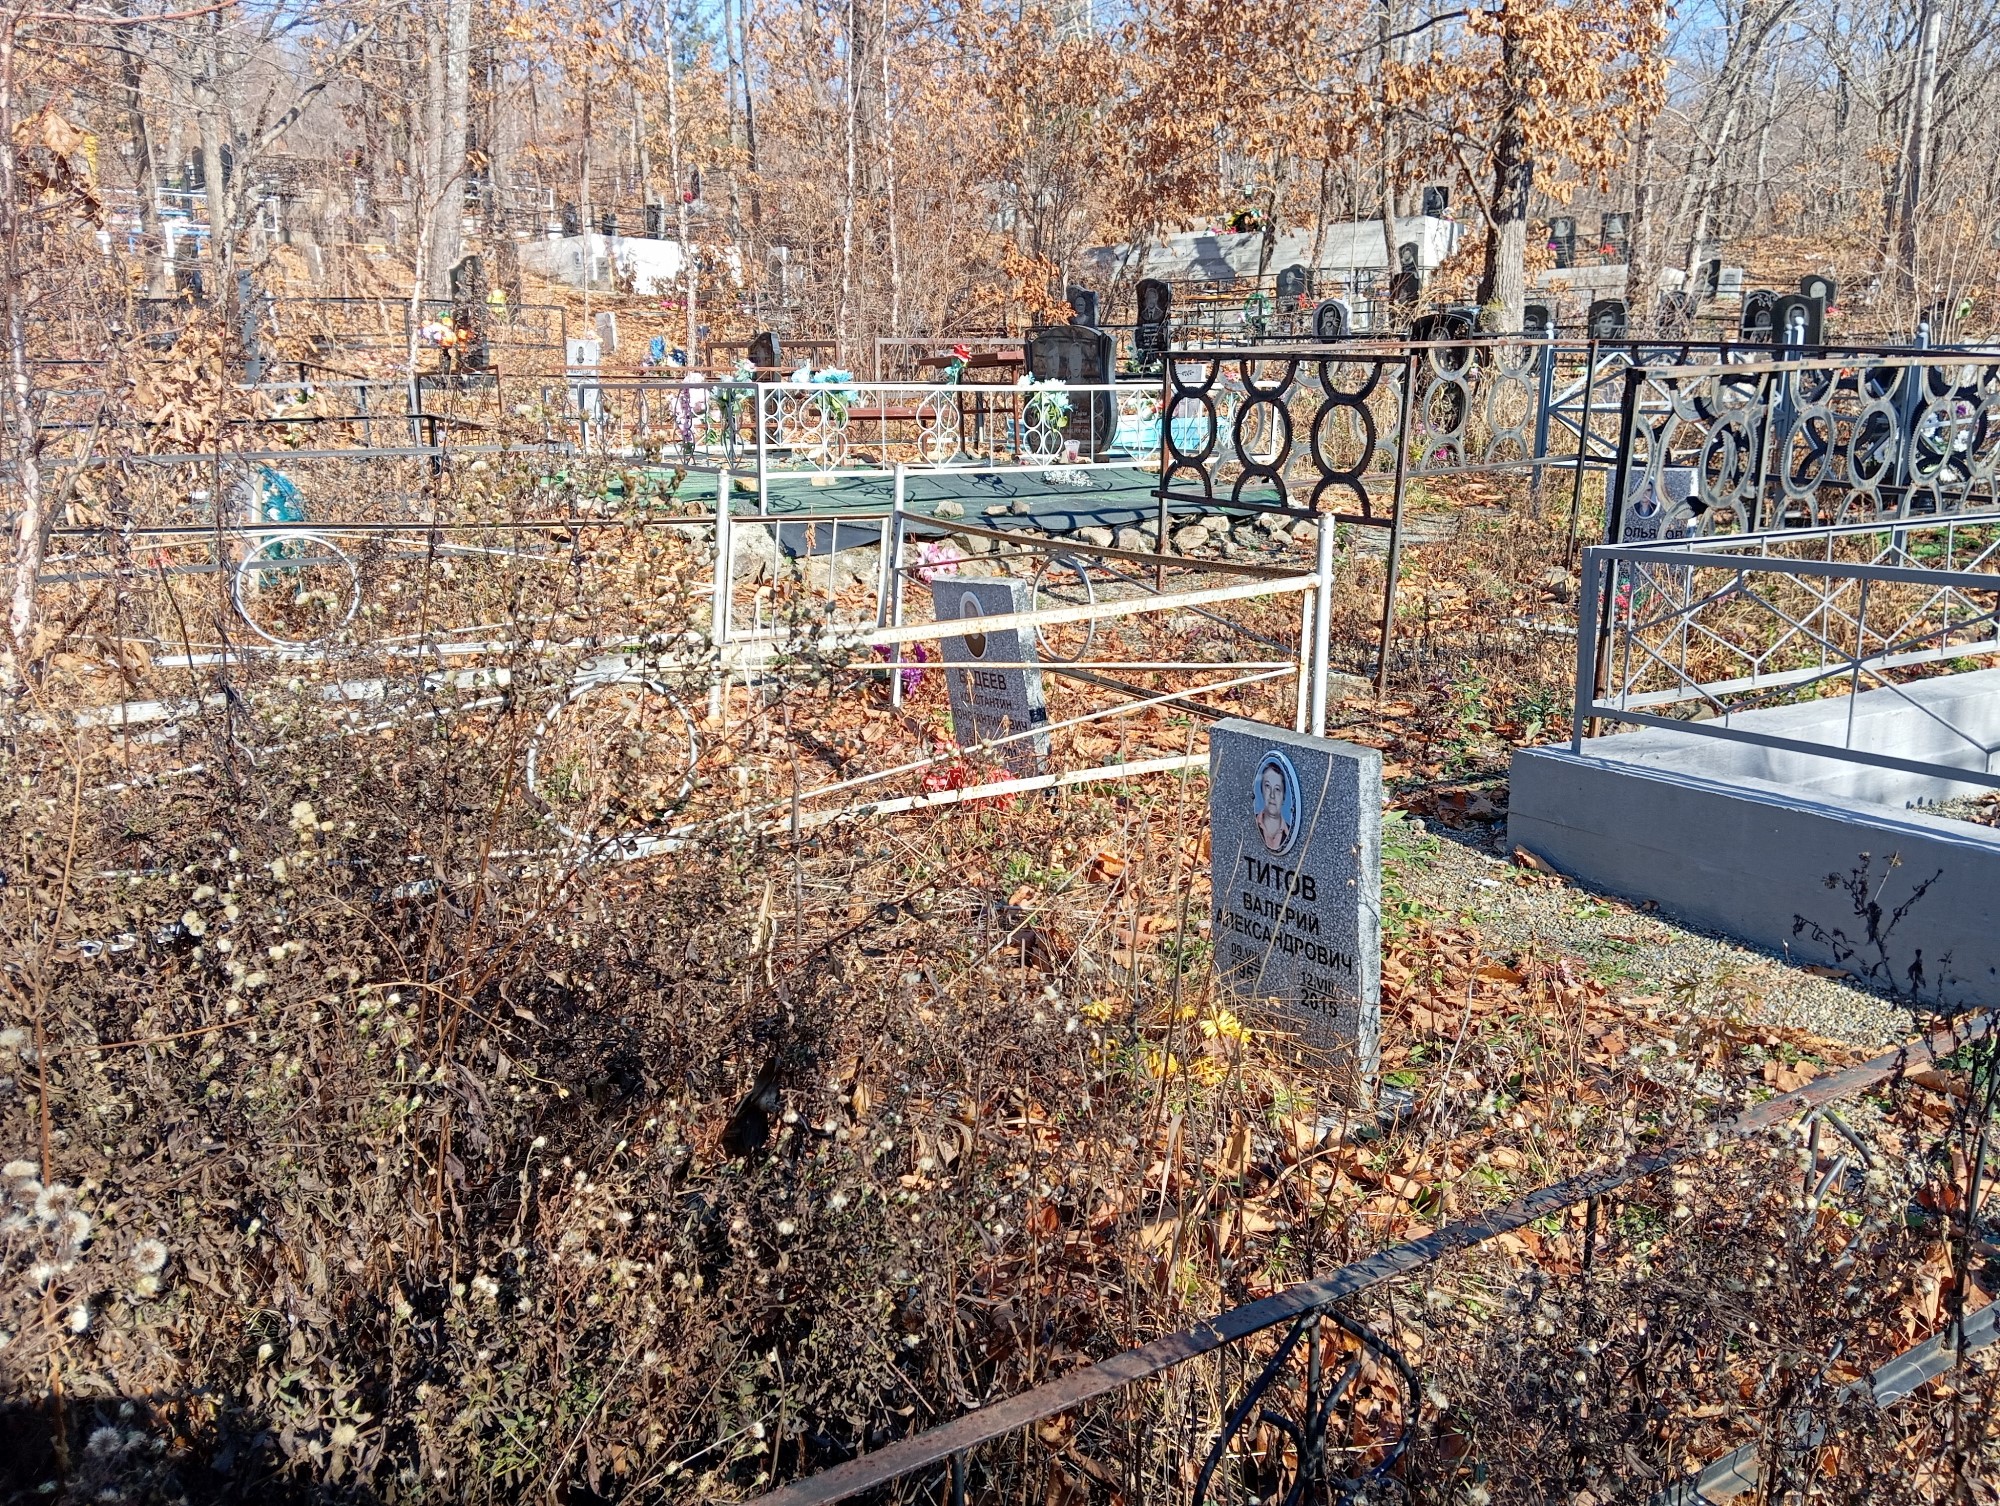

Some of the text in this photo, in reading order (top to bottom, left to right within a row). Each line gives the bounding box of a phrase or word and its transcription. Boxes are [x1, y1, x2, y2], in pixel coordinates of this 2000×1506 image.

[958, 667, 1007, 691] ВДЕЕВ
[952, 707, 1028, 731] КОНСАНТИНВИЧ
[1243, 855, 1317, 902] ТИТОВ
[1243, 891, 1320, 936] ВАЛЕРИЙ
[1216, 908, 1352, 975] АЛЕКСАНДРОВИЧ
[1300, 988, 1338, 1018] 2015
